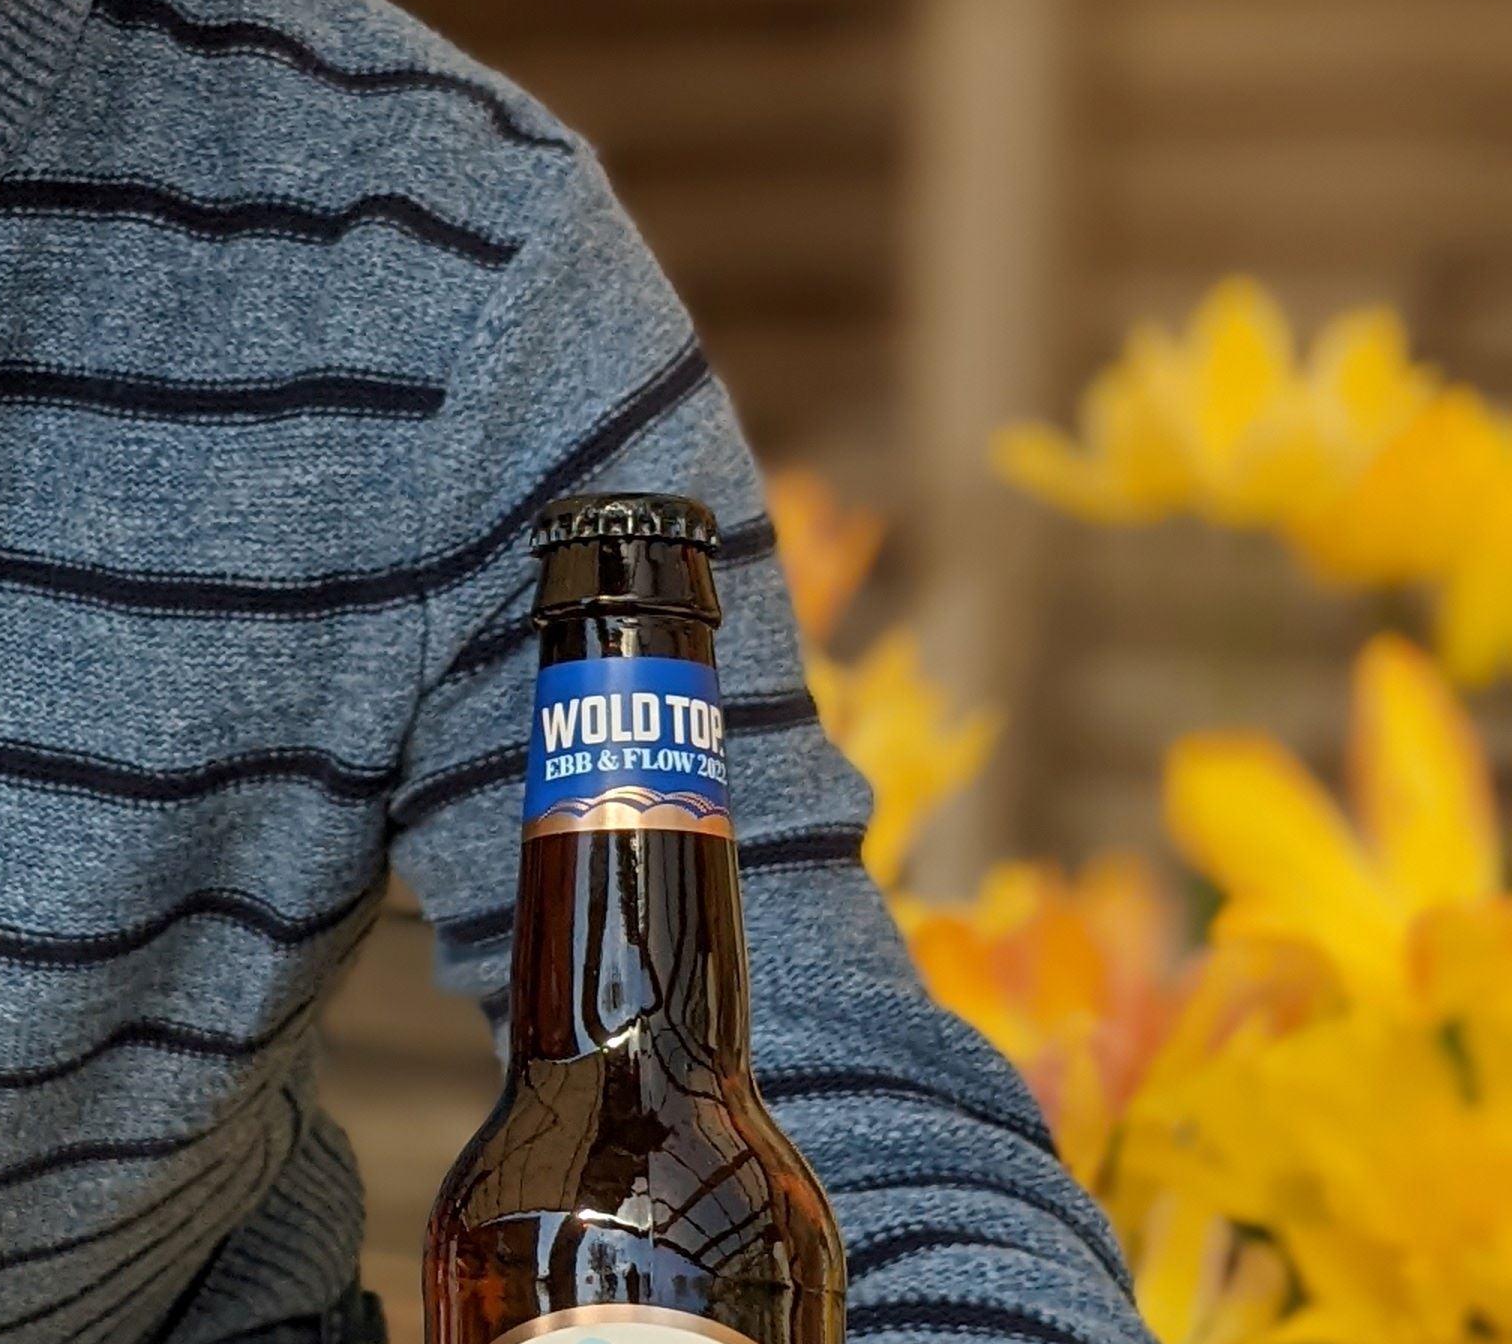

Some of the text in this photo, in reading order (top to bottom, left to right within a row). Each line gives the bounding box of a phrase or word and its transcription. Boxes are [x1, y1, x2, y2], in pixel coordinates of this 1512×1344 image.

[544, 751, 593, 782] EBB
[596, 748, 619, 772] &
[622, 746, 696, 774] FLOW
